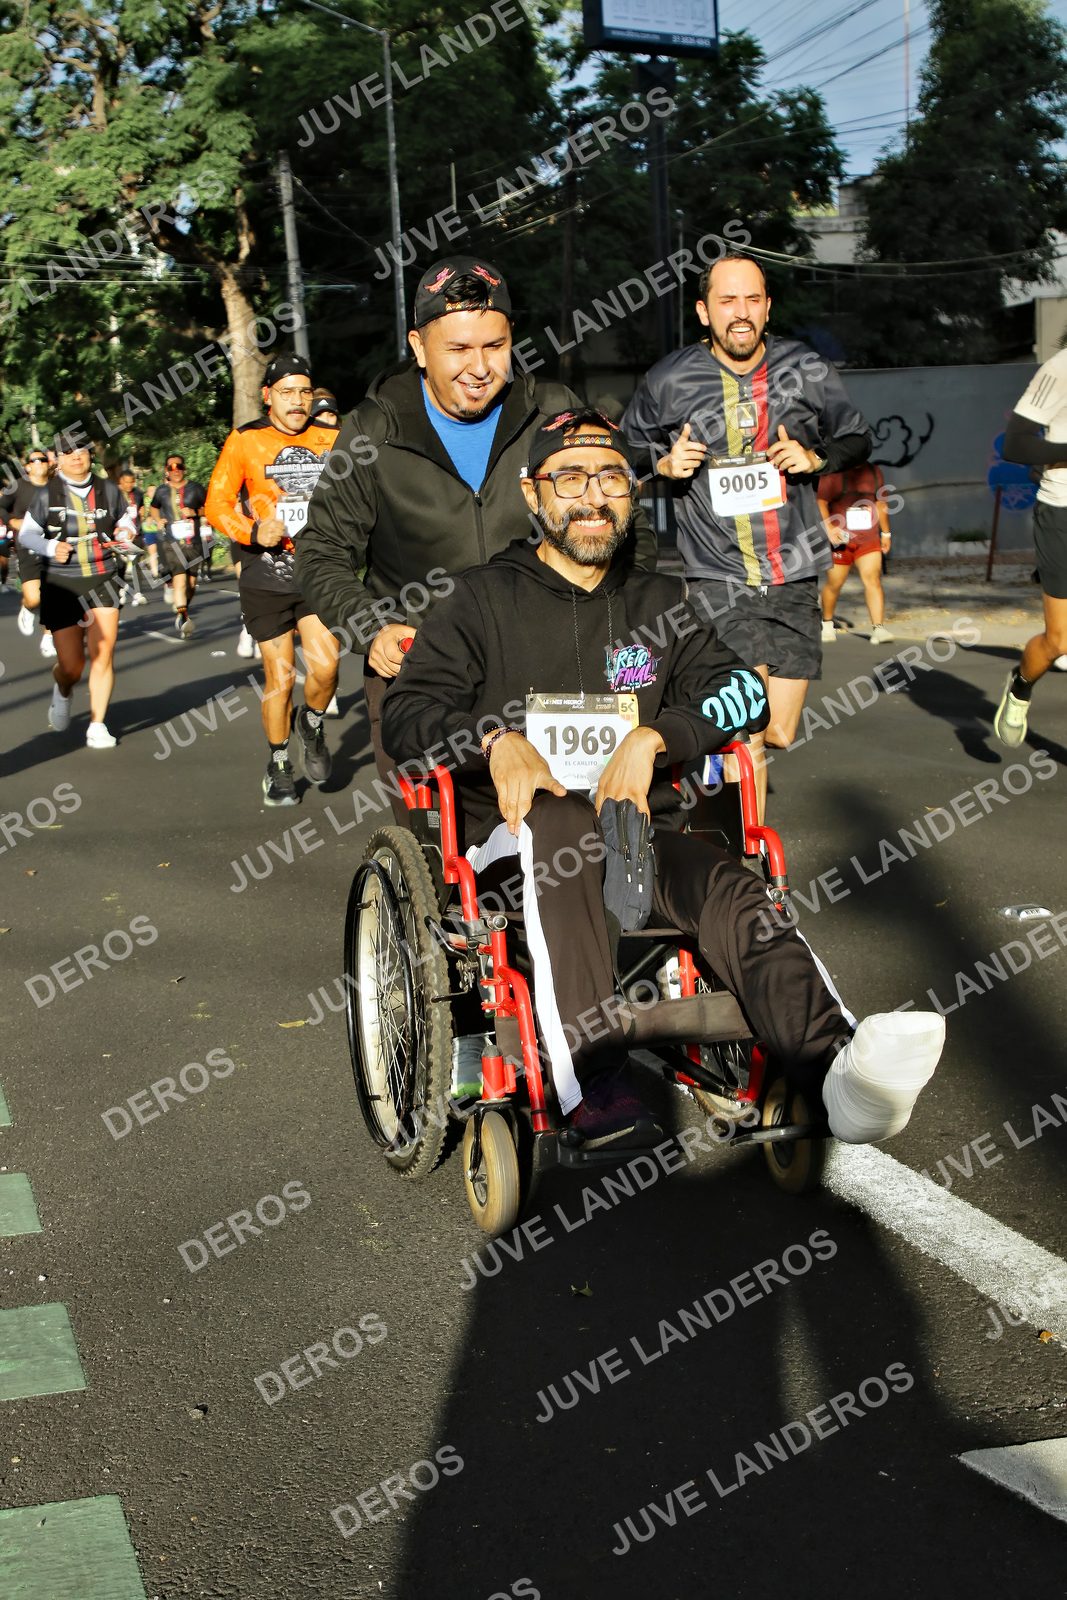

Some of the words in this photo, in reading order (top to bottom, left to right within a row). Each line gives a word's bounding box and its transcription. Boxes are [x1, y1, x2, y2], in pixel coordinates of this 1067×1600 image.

[720, 471, 768, 495] 9005
[616, 649, 648, 672] RETO
[615, 663, 651, 686] FINAL
[544, 725, 617, 756] 1969
